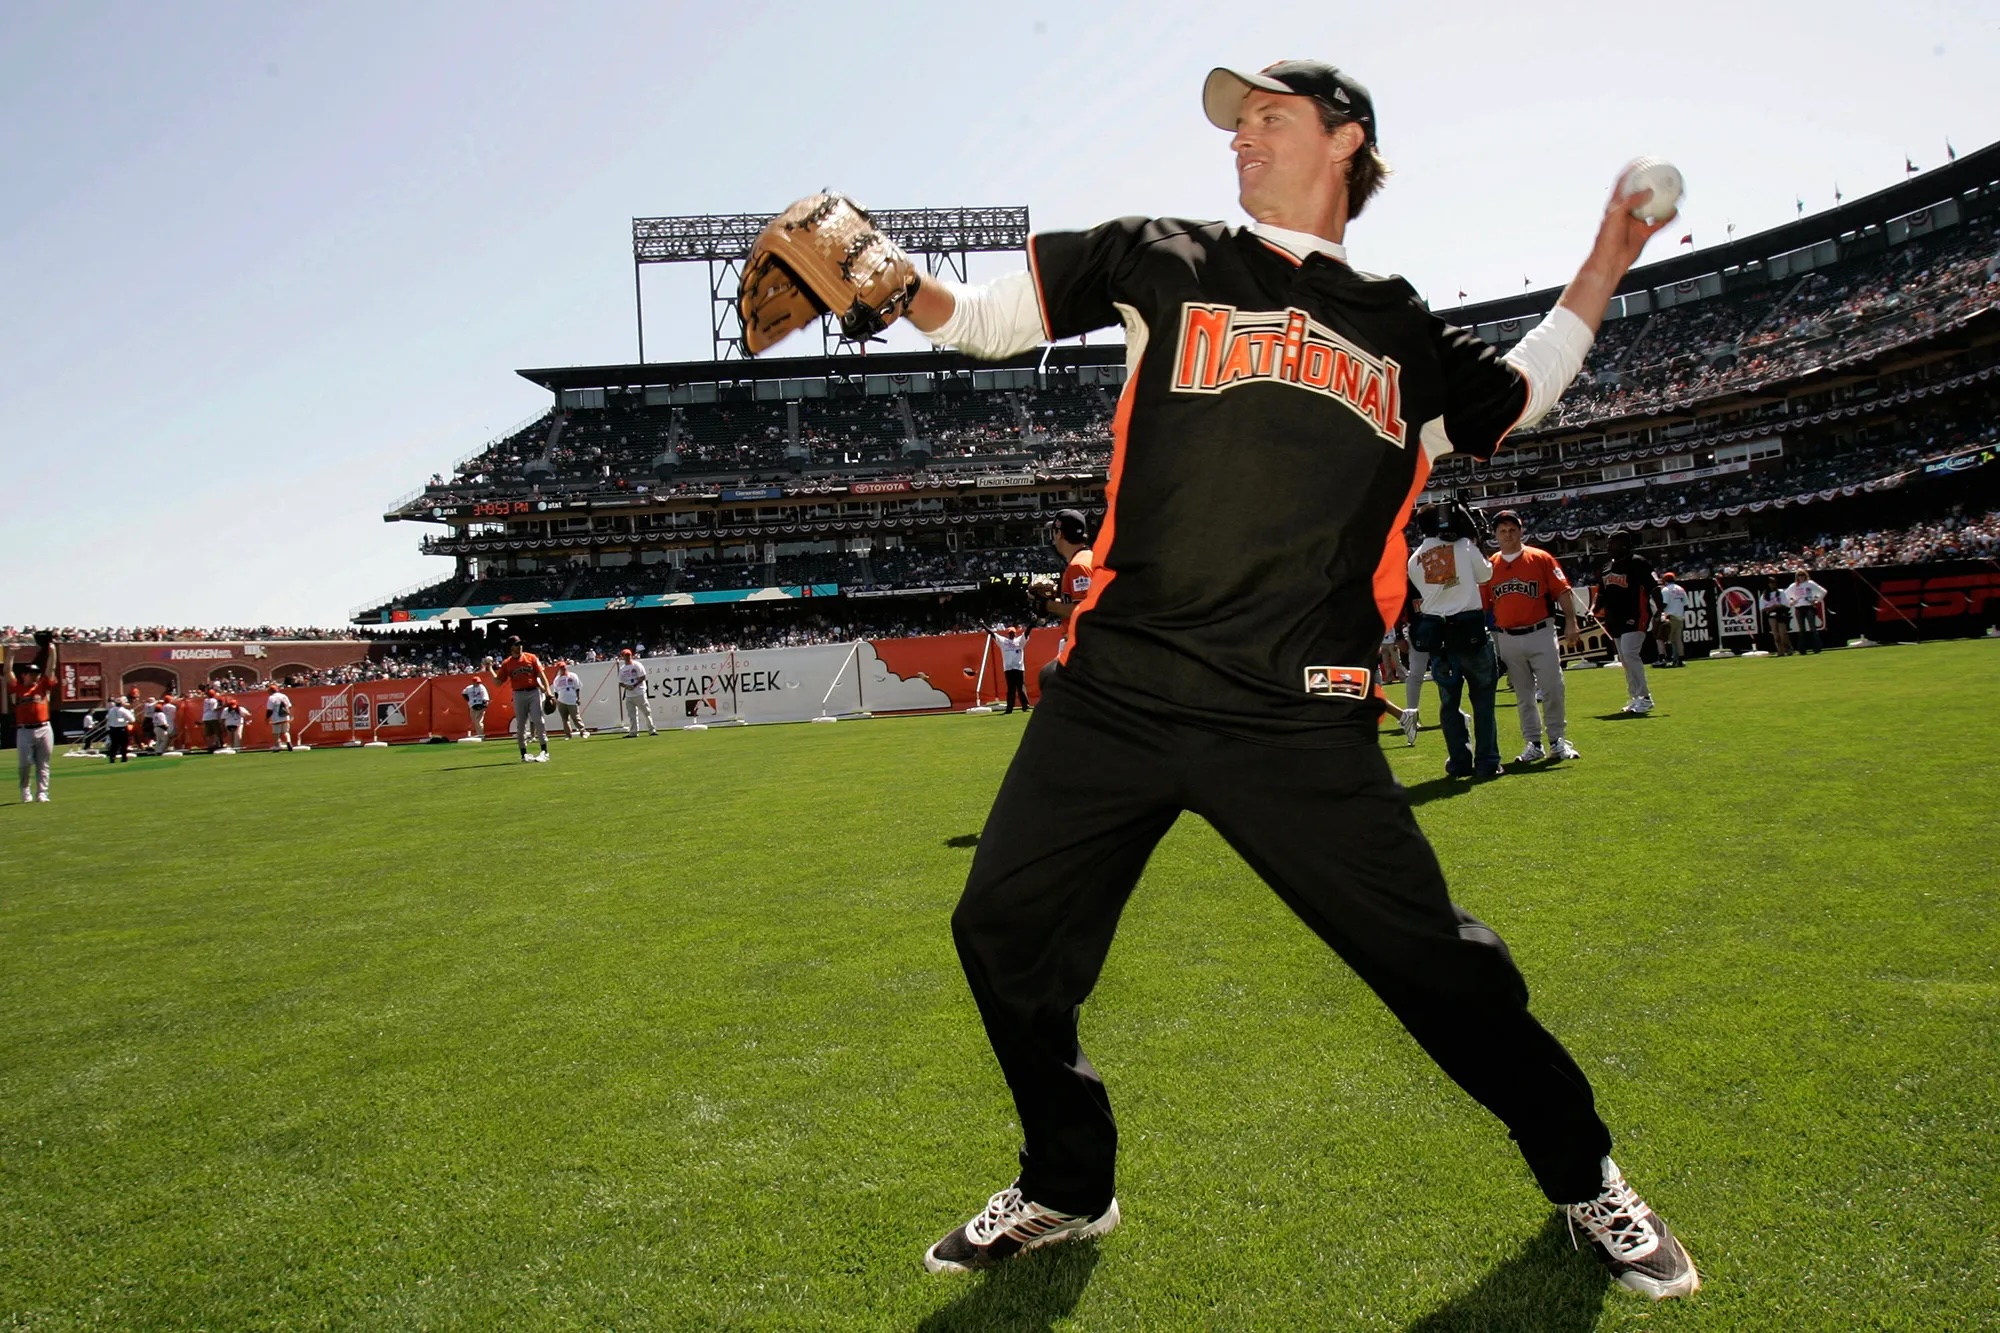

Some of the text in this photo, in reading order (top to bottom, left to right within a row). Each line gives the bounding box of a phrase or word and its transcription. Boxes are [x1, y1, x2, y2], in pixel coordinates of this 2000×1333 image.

[1171, 302, 1407, 449] NATIONAL
[869, 482, 905, 492] TOYOTA
[978, 477, 1029, 487] FusionStorm
[514, 502, 529, 513] PM
[1722, 617, 1754, 625] TACO
[171, 649, 218, 659] KRAGEN
[676, 660, 750, 672] FRANCISCO
[717, 670, 781, 693] WEEK
[321, 693, 349, 708] THINK
[309, 708, 349, 721] OUTSIDE
[321, 722, 334, 731] THE
